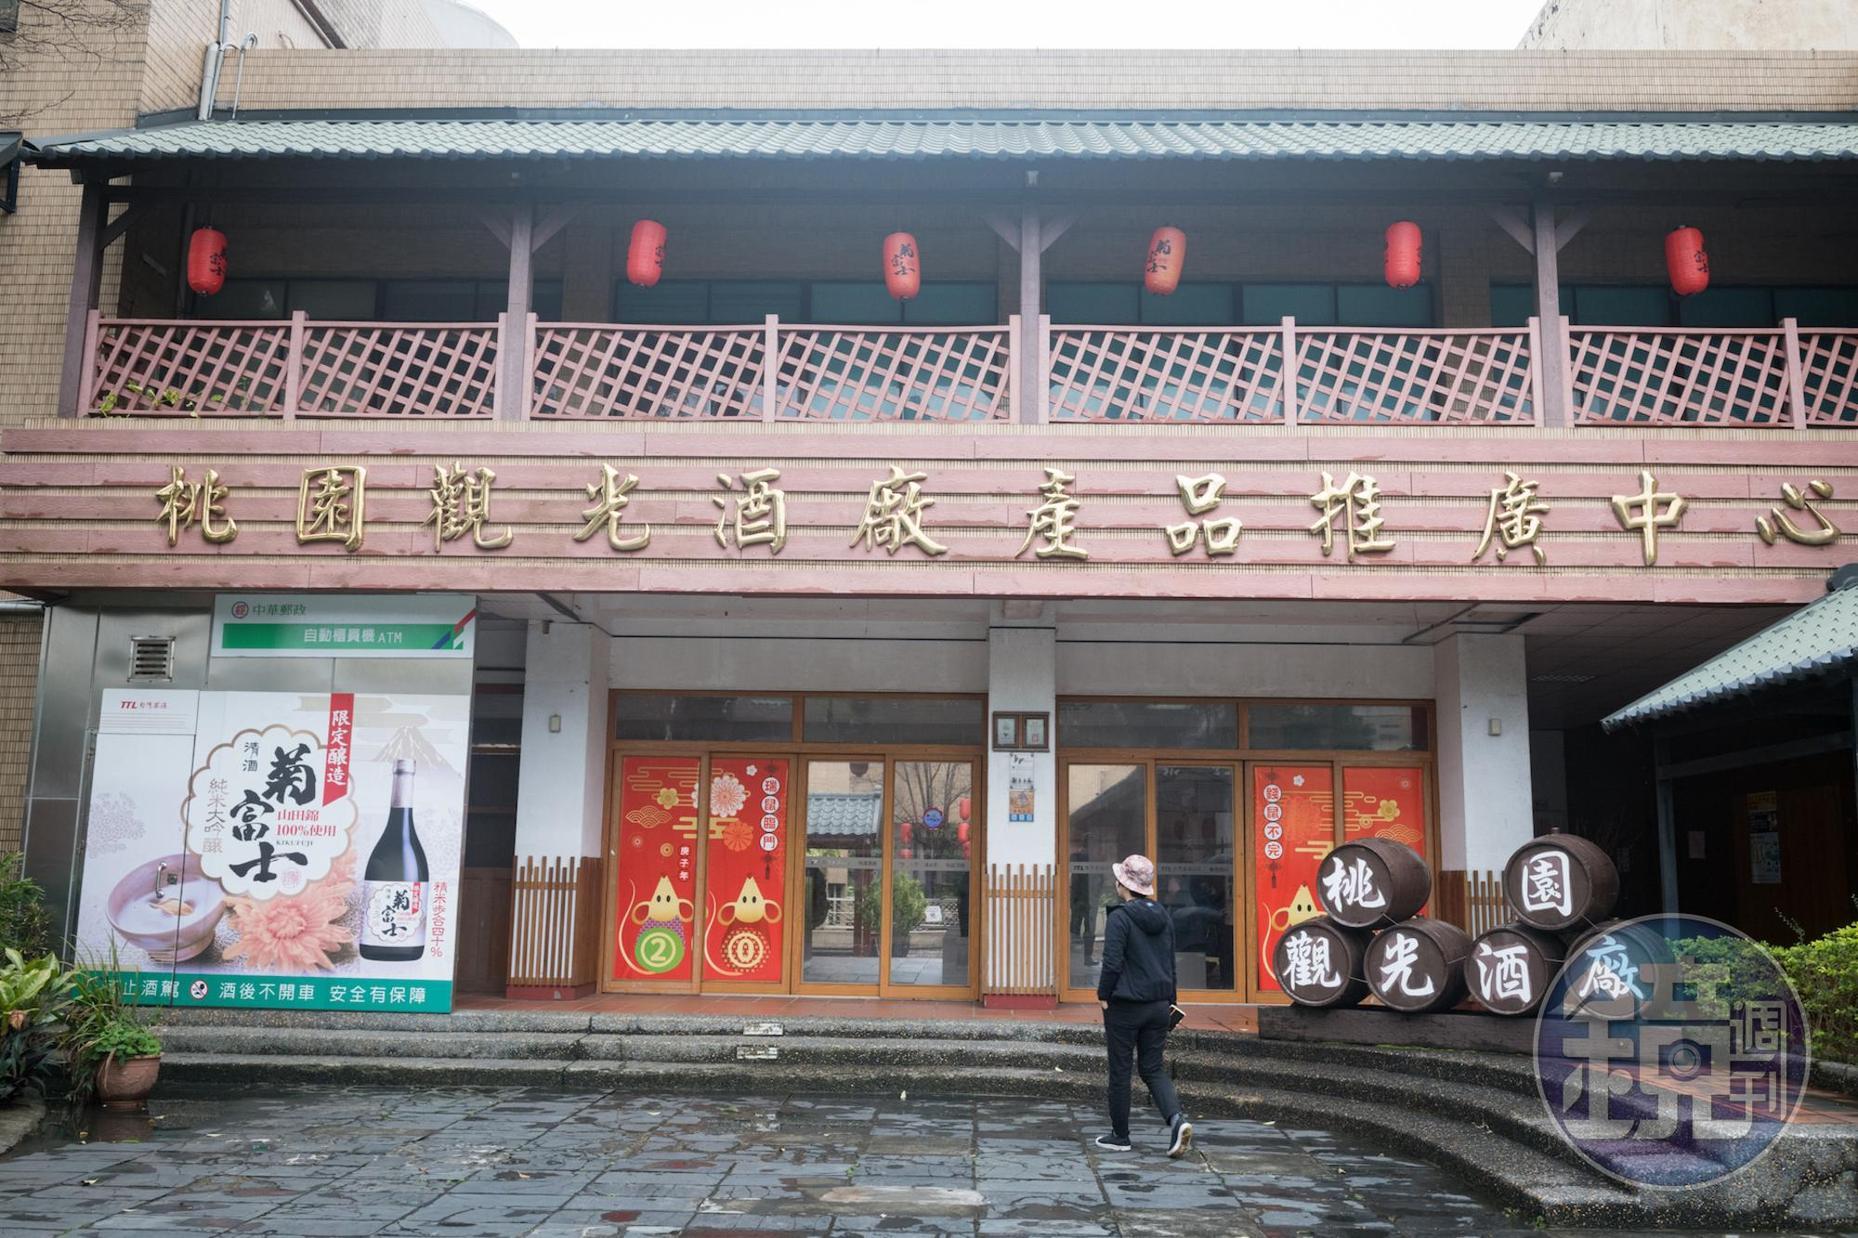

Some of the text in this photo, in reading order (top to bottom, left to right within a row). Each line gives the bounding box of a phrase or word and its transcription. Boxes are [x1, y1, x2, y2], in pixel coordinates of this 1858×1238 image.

[155, 463, 1843, 567] 桃園觀光酒廠產品推廣中心
[252, 604, 307, 616] 中華郵政
[303, 627, 403, 644] 自動櫃員機 ATM
[120, 701, 138, 709] TTL
[242, 741, 260, 772] 清酒
[326, 709, 351, 787] 限定釀造
[229, 743, 317, 883] 菊富士
[276, 809, 320, 822] 山田錦
[276, 824, 337, 837] 100%使用
[381, 889, 410, 937] 菊富士
[218, 981, 315, 1001] 酒後不開車
[329, 985, 427, 1004] 安全有保障
